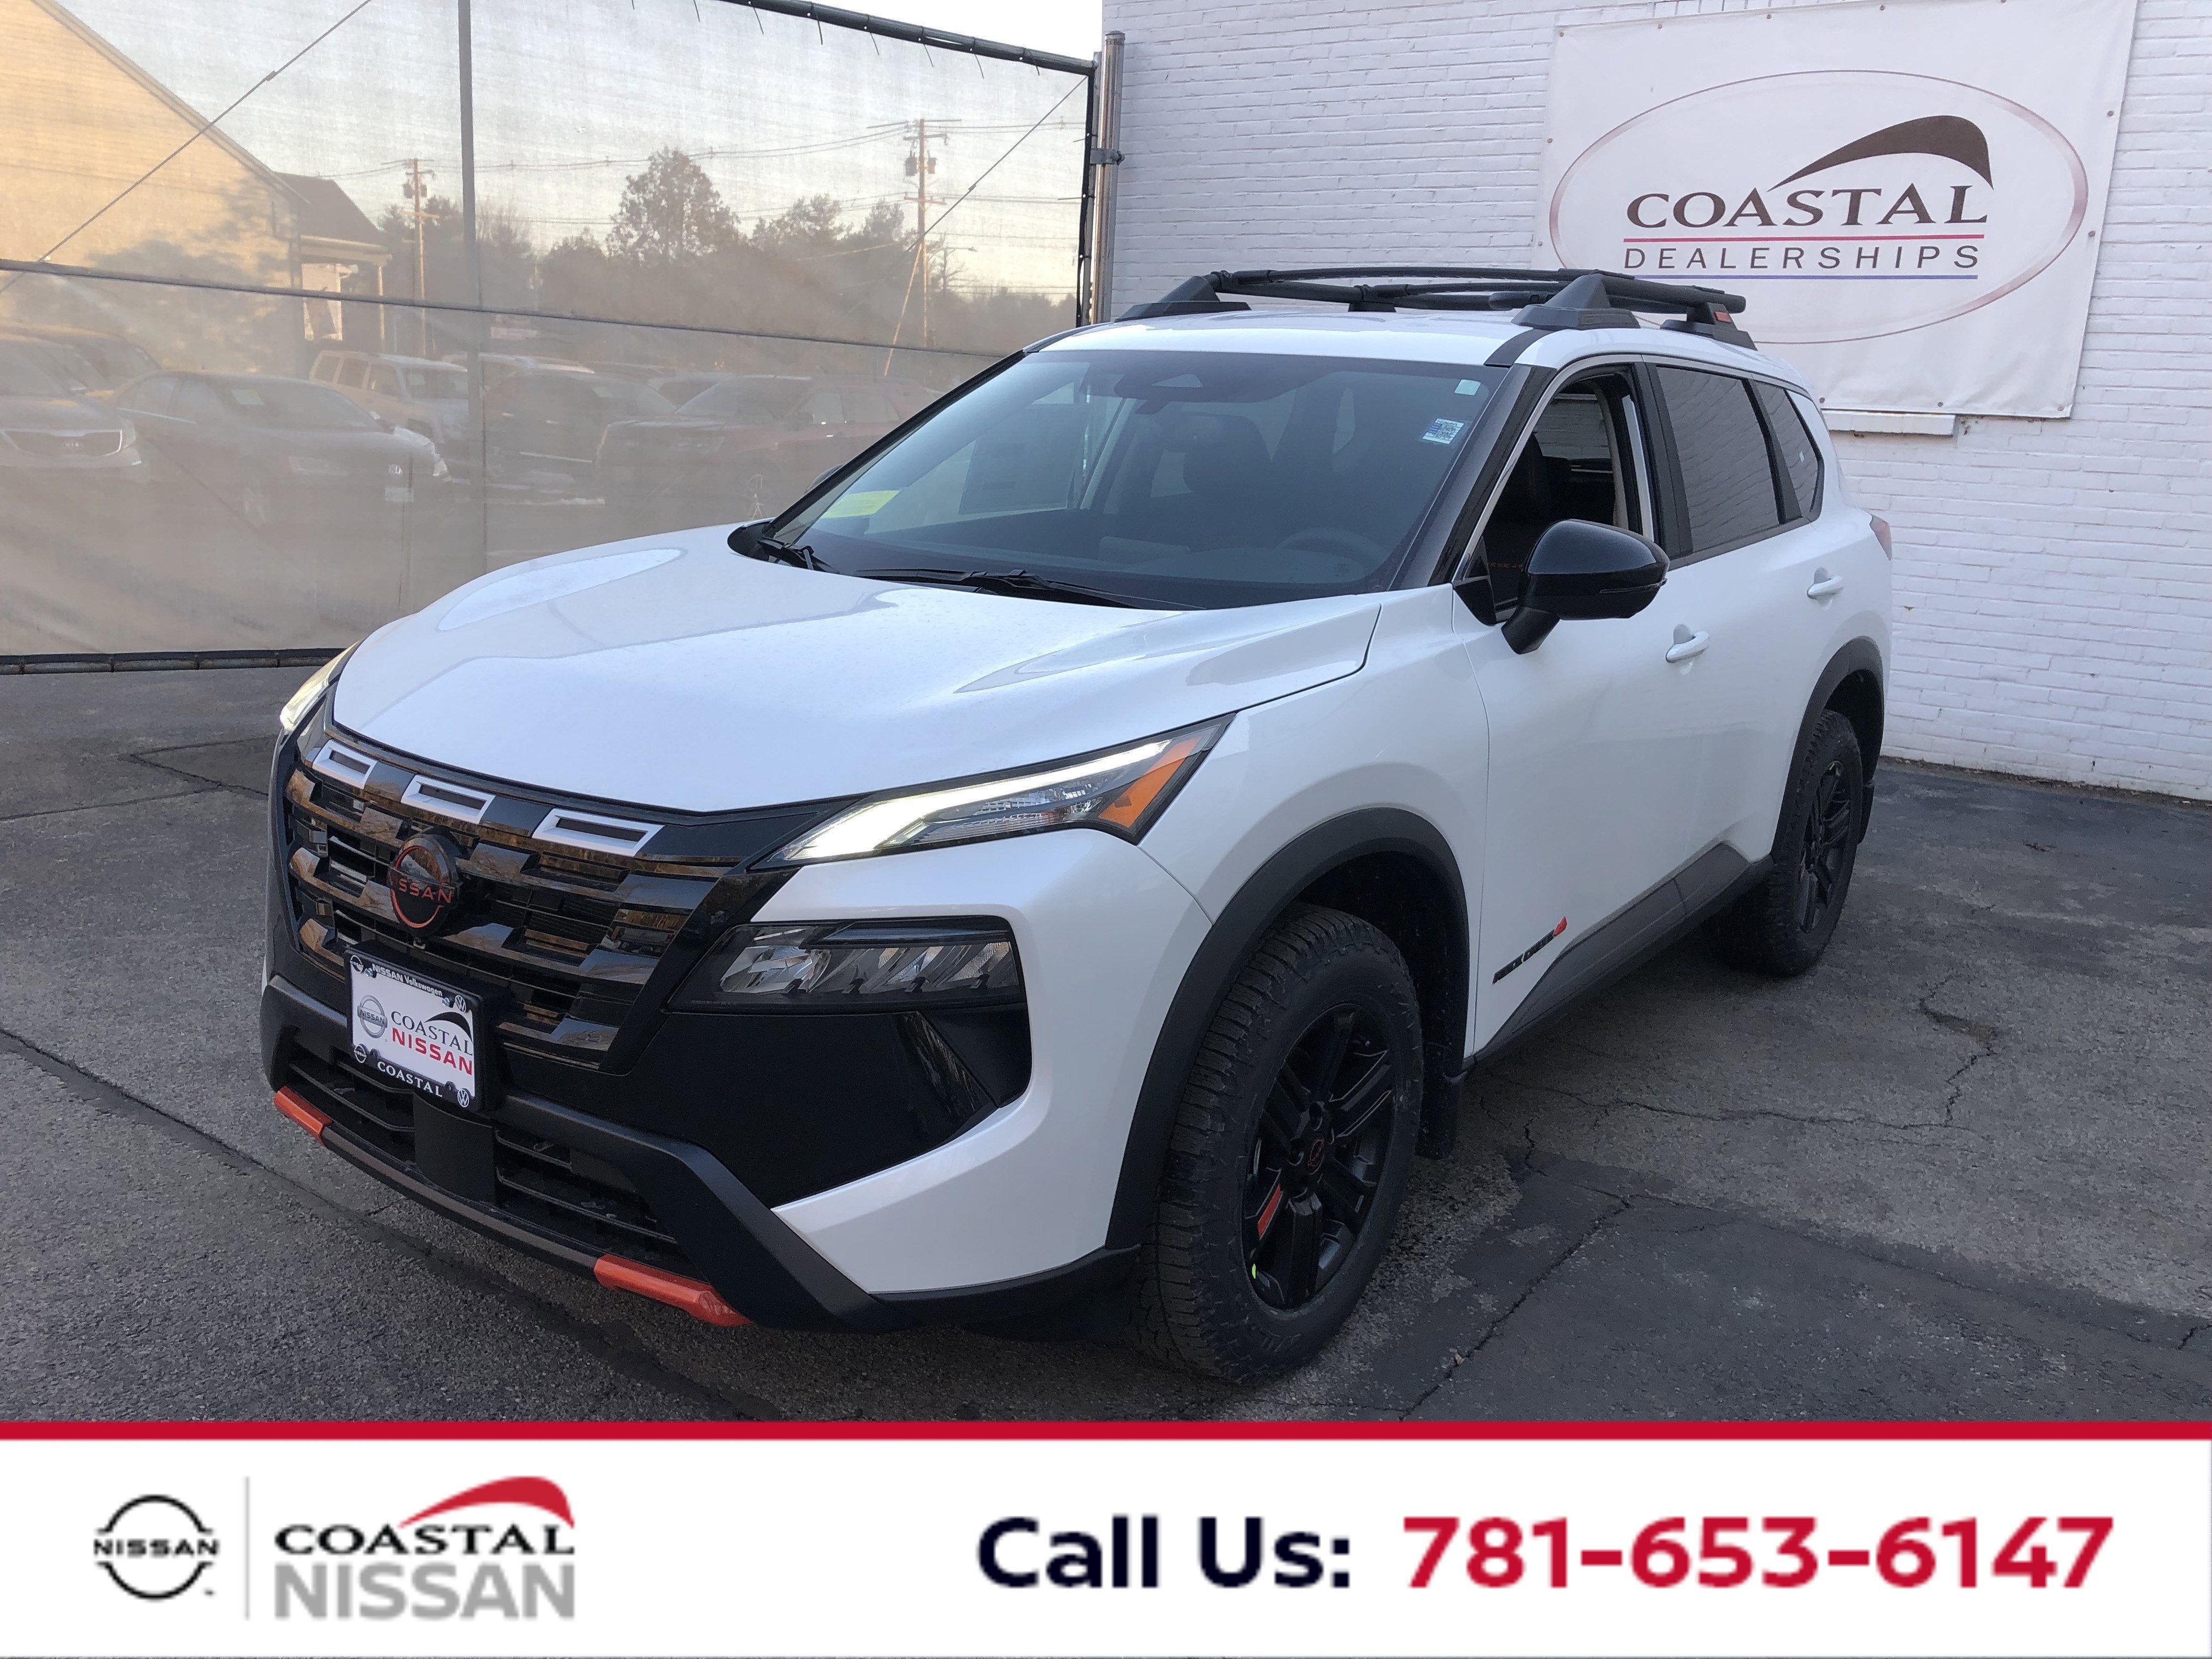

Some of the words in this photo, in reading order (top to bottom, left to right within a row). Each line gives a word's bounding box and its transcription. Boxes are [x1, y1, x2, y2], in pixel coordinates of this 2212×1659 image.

[1627, 183, 1988, 228] COASTAL
[1624, 245, 1978, 269] DEALERSHIPS
[390, 871, 455, 904] SSAN
[372, 963, 404, 983] NISSAN
[404, 975, 443, 998] Volkswagen
[360, 1009, 385, 1025] NISSAN
[391, 1011, 473, 1056] COASTAL
[392, 1027, 472, 1075] NISSAN
[377, 1061, 443, 1097] COASTAL
